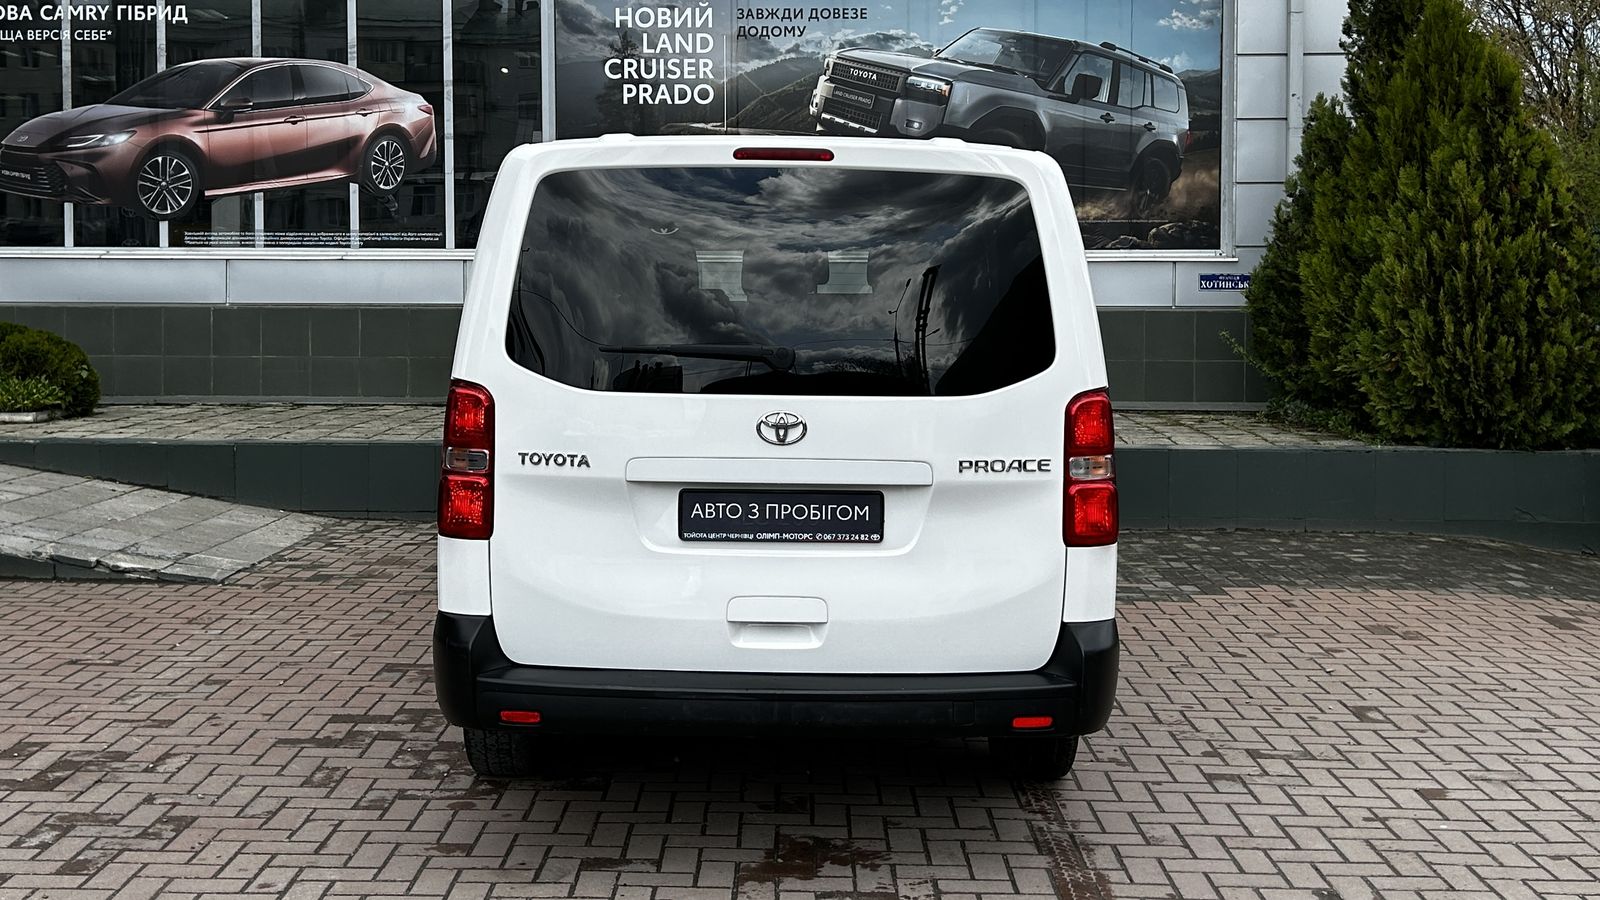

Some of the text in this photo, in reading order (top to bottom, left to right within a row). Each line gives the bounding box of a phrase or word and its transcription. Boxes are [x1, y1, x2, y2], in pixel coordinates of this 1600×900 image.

[40, 5, 110, 21] CAMRY
[117, 5, 188, 24] ГІБРИД
[615, 2, 713, 29] НОВИЙ
[736, 7, 868, 21] ЗАВЖДИ ДОВЕЗЕ
[27, 30, 71, 41] ВЕРСІЯ
[736, 25, 807, 40] ДОДОМУ
[642, 33, 714, 54] LAND
[604, 58, 715, 80] CRUISER
[849, 67, 877, 81] TOYOTA
[622, 84, 715, 105] PRADO
[517, 452, 591, 468] TOYOTA
[958, 459, 1052, 474] PROACE
[690, 502, 743, 519] АВТО
[765, 503, 870, 521] ПРОБІГОМ
[683, 531, 707, 539] ТОЙОТА
[707, 532, 727, 540] ЦЕНТР
[755, 532, 814, 541] ОЛІМП-МОТОРС
[823, 533, 836, 541] 067
[836, 533, 850, 541] 373
[850, 533, 859, 541] 24
[859, 533, 869, 541] 82
